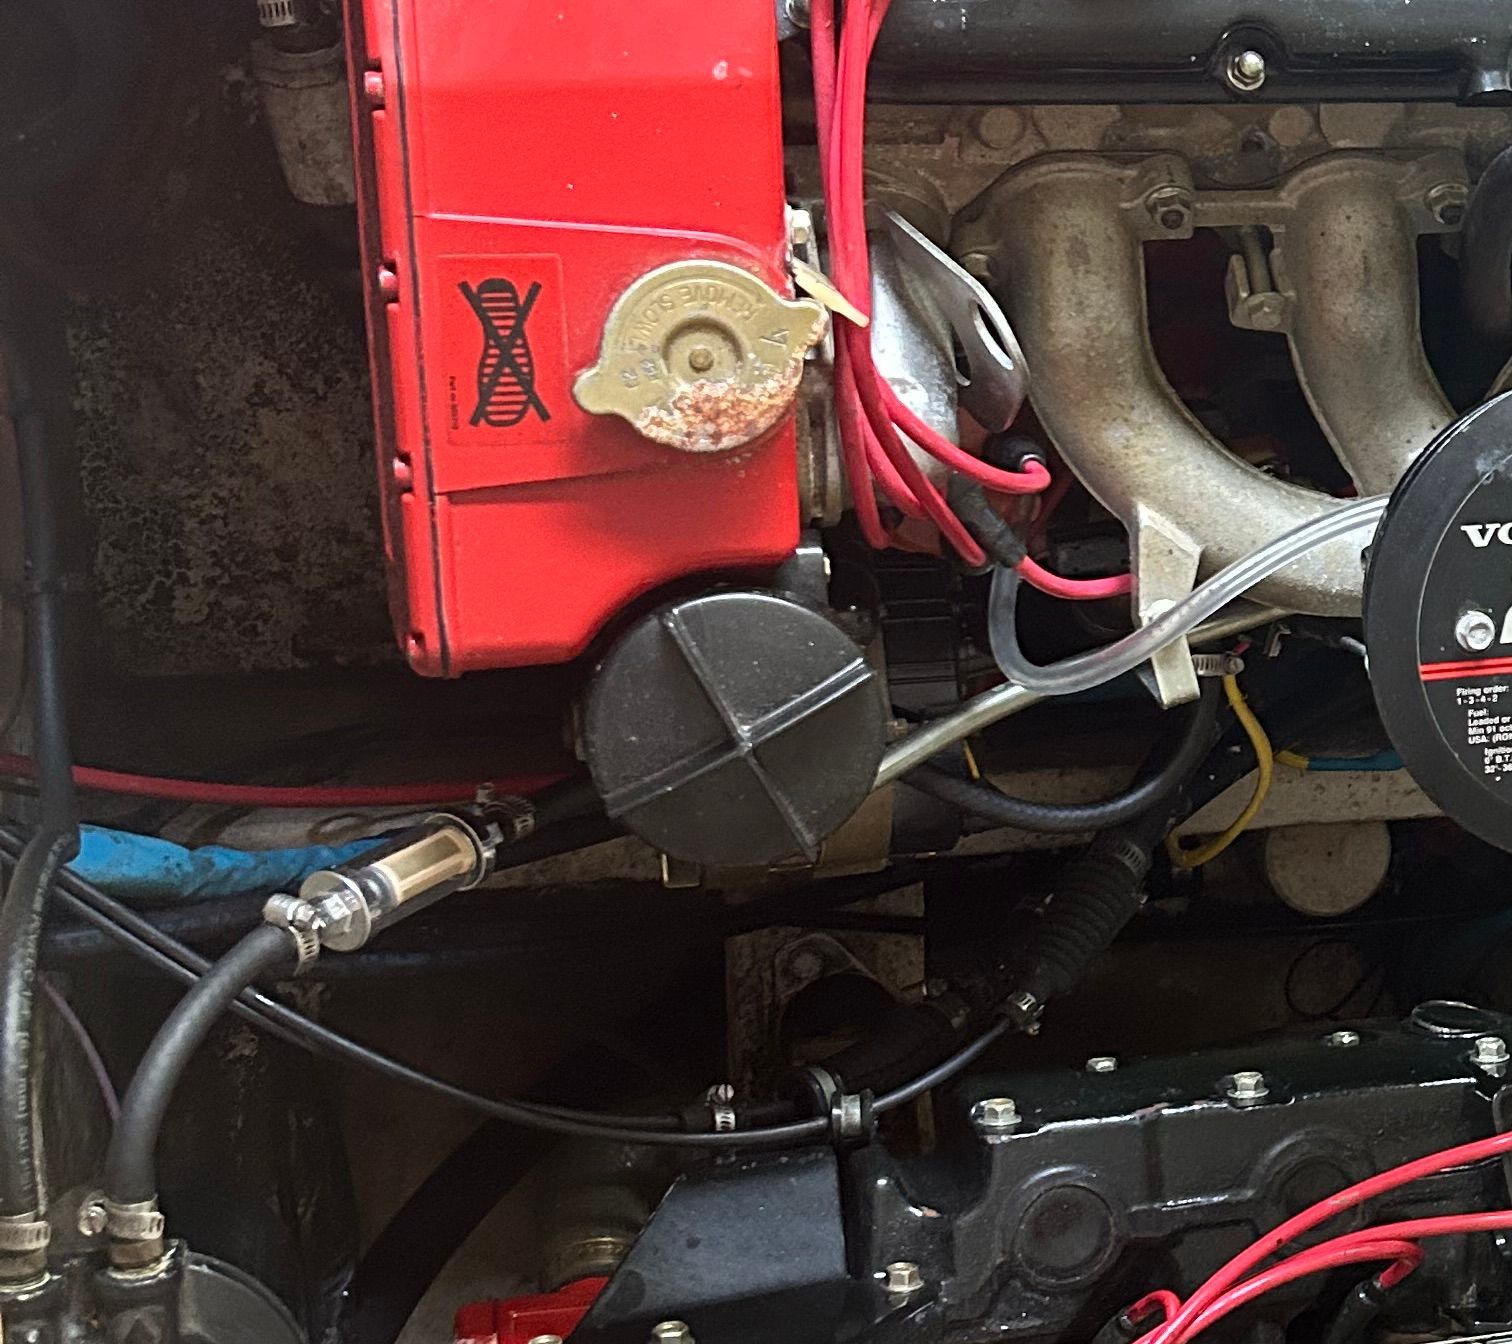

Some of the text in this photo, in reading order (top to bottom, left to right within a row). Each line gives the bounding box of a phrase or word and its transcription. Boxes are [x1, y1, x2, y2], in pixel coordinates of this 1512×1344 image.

[679, 285, 764, 321] REMOVE
[1456, 686, 1481, 696] Firing
[1468, 726, 1485, 735] Min
[1486, 725, 1496, 734] 91
